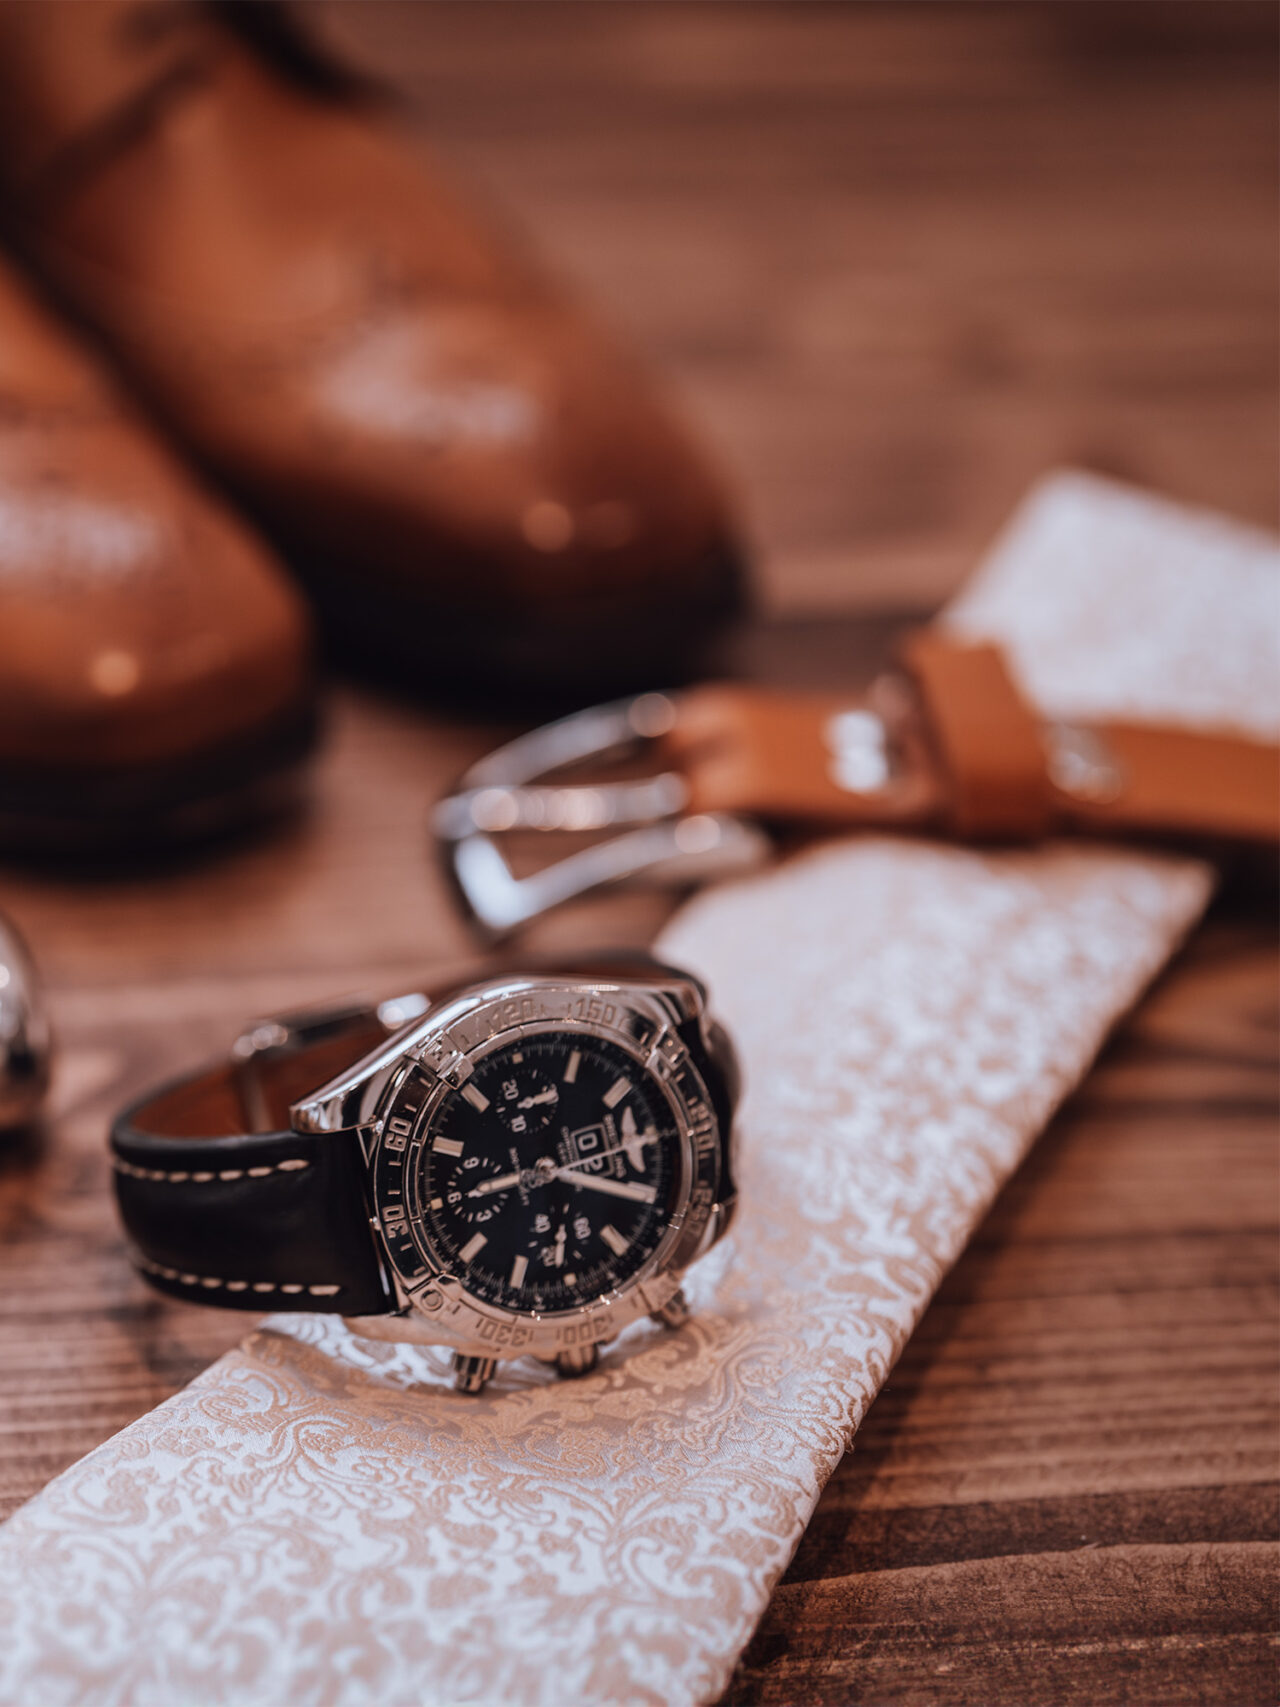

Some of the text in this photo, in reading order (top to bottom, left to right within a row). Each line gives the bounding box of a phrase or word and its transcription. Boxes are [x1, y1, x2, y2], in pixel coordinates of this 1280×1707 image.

[488, 999, 536, 1029] 120
[575, 999, 617, 1025] 150
[502, 1079, 519, 1100] 20
[385, 1117, 412, 1151] 60
[511, 1114, 526, 1133] 10
[463, 1156, 480, 1169] 9
[447, 1191, 462, 1204] 6
[382, 1204, 409, 1239] 30
[476, 1209, 493, 1222] 3
[479, 1321, 527, 1347] 330
[563, 1317, 609, 1344] 300
